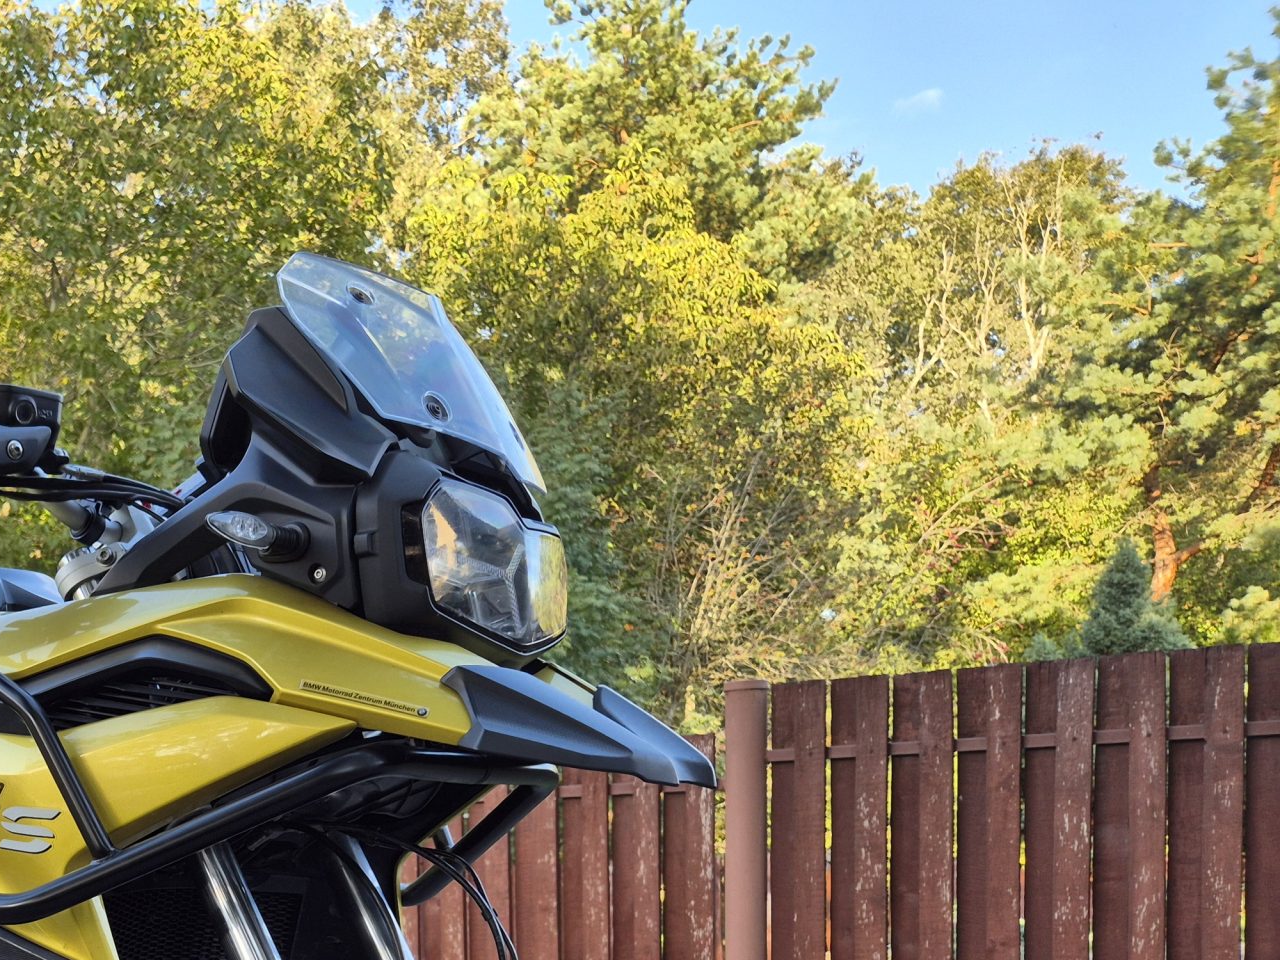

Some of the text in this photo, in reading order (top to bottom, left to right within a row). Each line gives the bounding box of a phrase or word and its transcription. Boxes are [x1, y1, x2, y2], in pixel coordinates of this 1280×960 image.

[302, 681, 416, 713] BMW Motorrad Zentrum München
